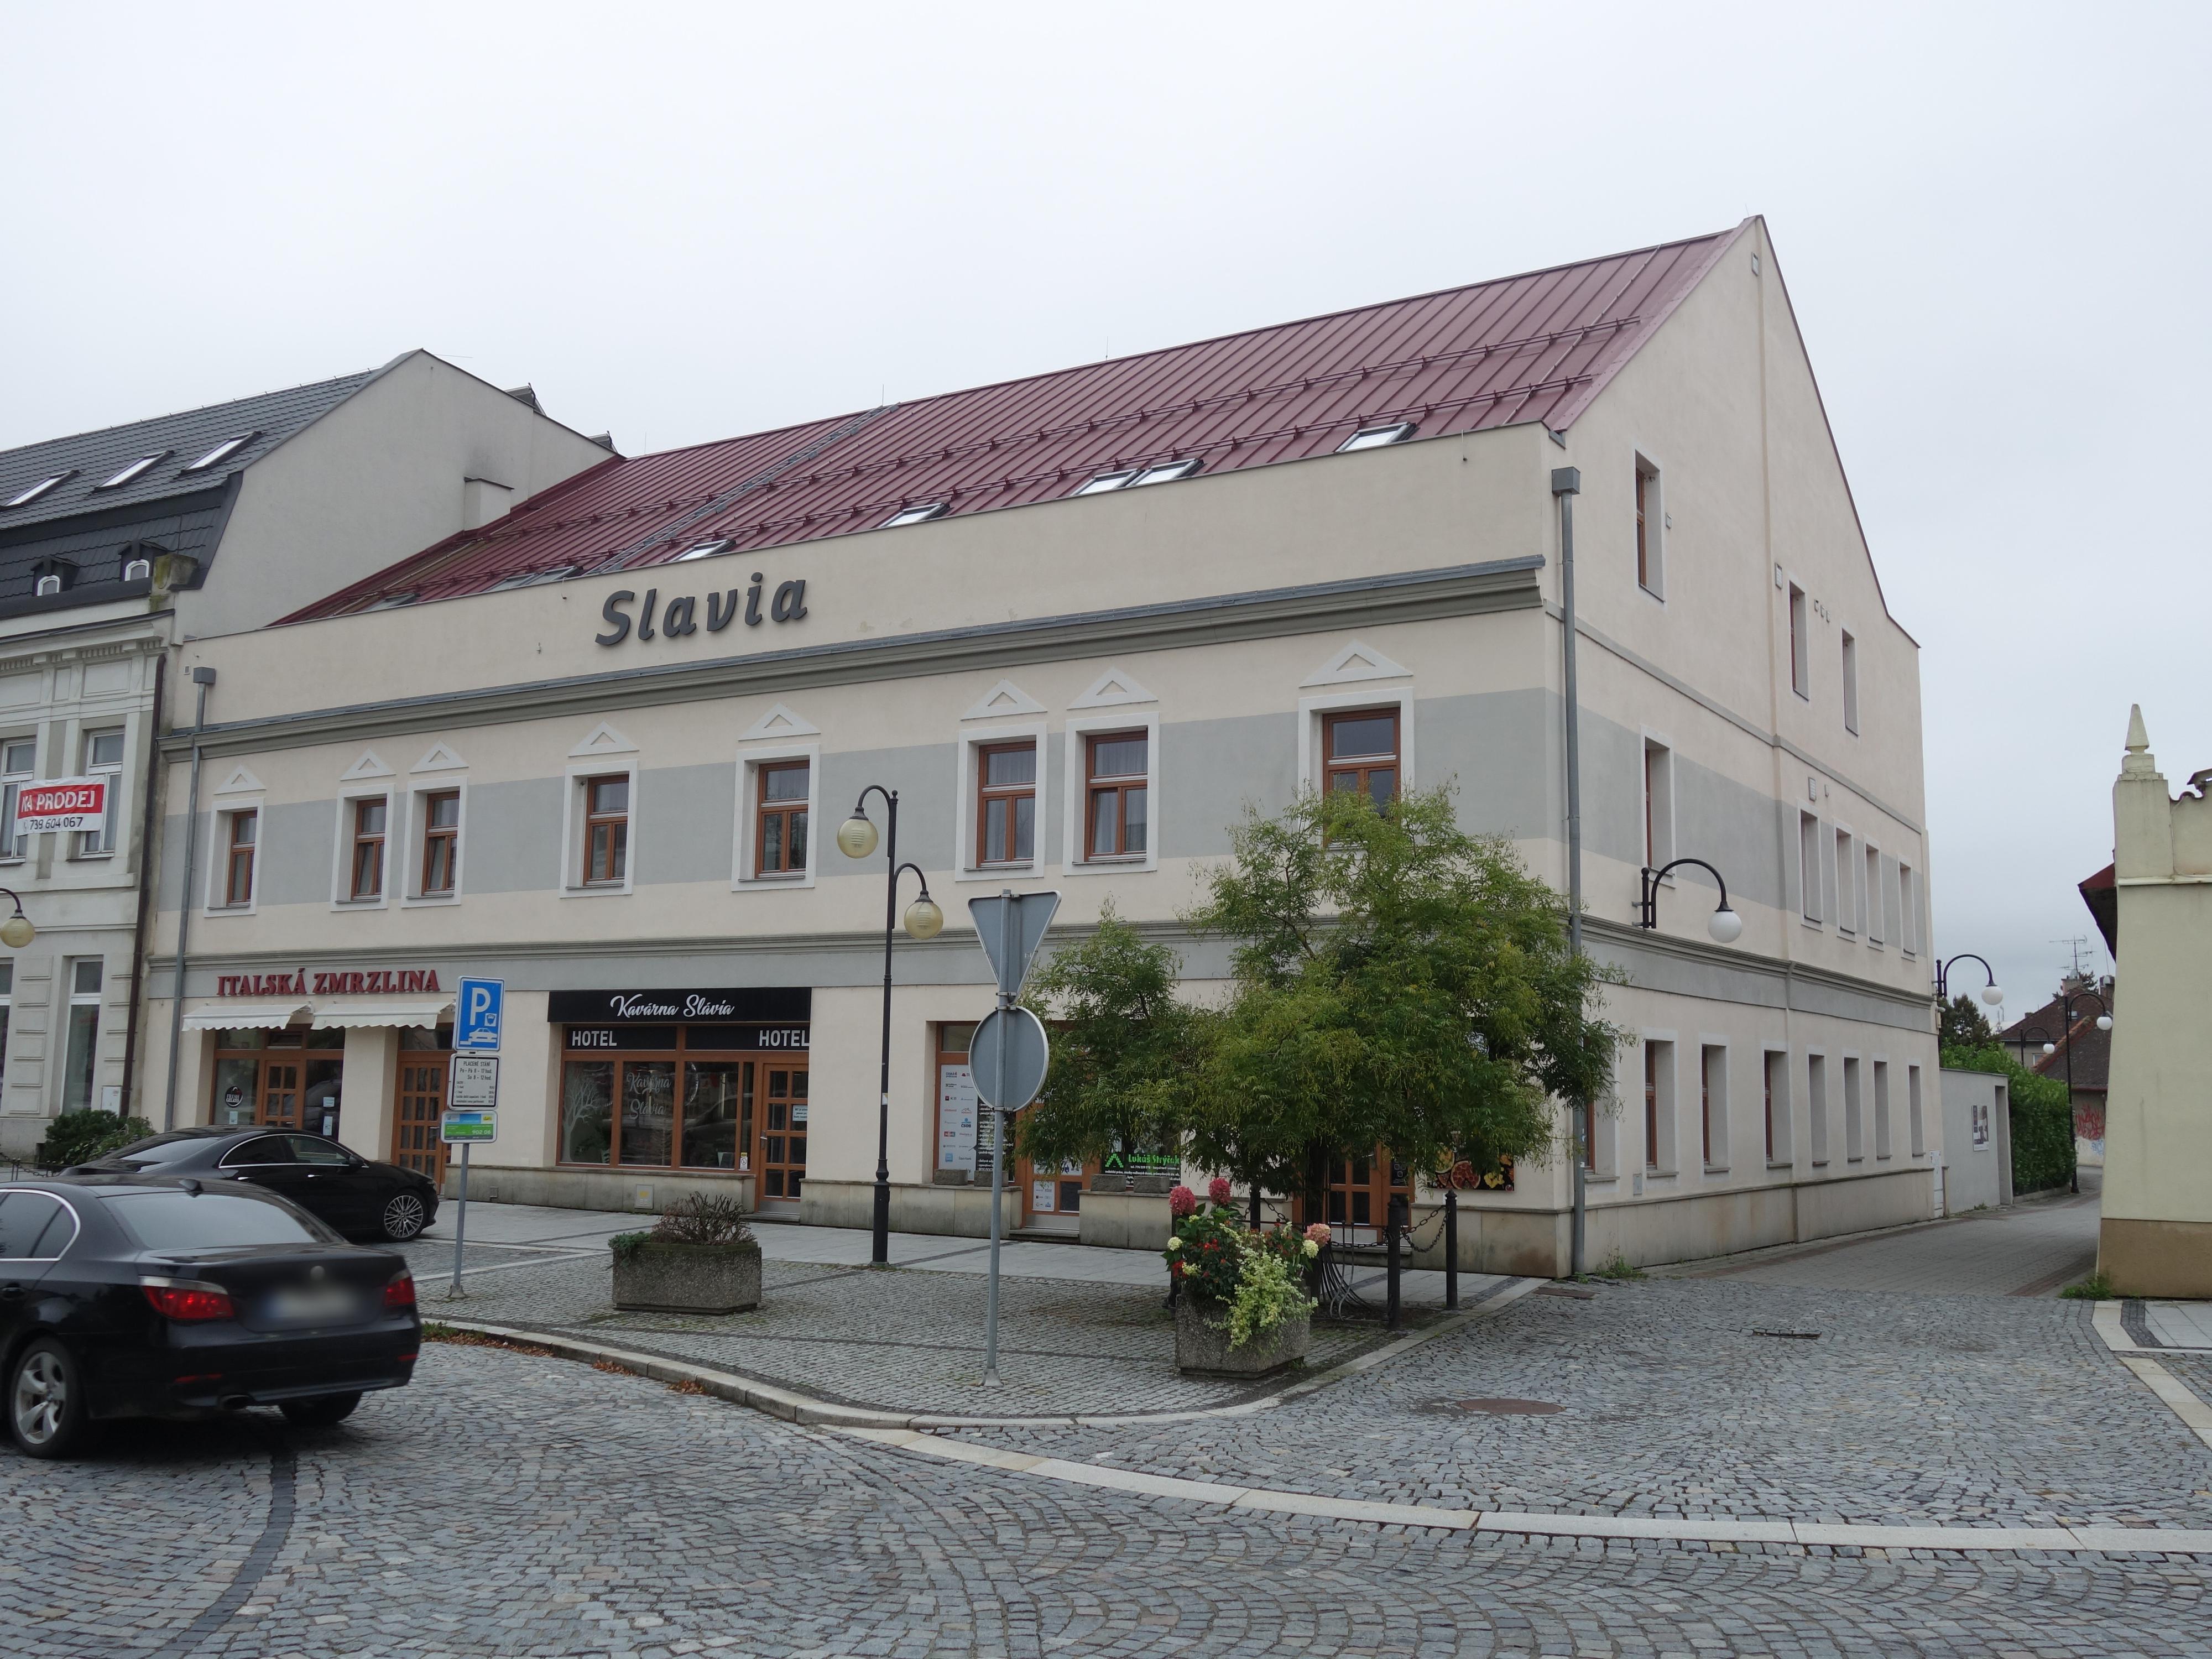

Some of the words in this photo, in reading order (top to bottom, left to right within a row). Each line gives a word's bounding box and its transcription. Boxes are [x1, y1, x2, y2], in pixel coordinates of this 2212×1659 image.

[595, 572, 808, 646] Slavia
[21, 795, 33, 812] NA
[36, 790, 95, 811] PRODEJ
[30, 819, 44, 830] 739
[45, 818, 61, 829] 604
[64, 817, 84, 827] 067
[217, 968, 307, 996] ITALSKÁ
[312, 969, 441, 994] ZMRZLINA
[469, 987, 491, 1025] P
[610, 994, 679, 1018] Kavárna
[683, 994, 735, 1017] Slávia
[572, 1030, 617, 1046] HOTEL
[758, 1030, 810, 1046] HOTEL
[1128, 1154, 1150, 1163] Lukáš
